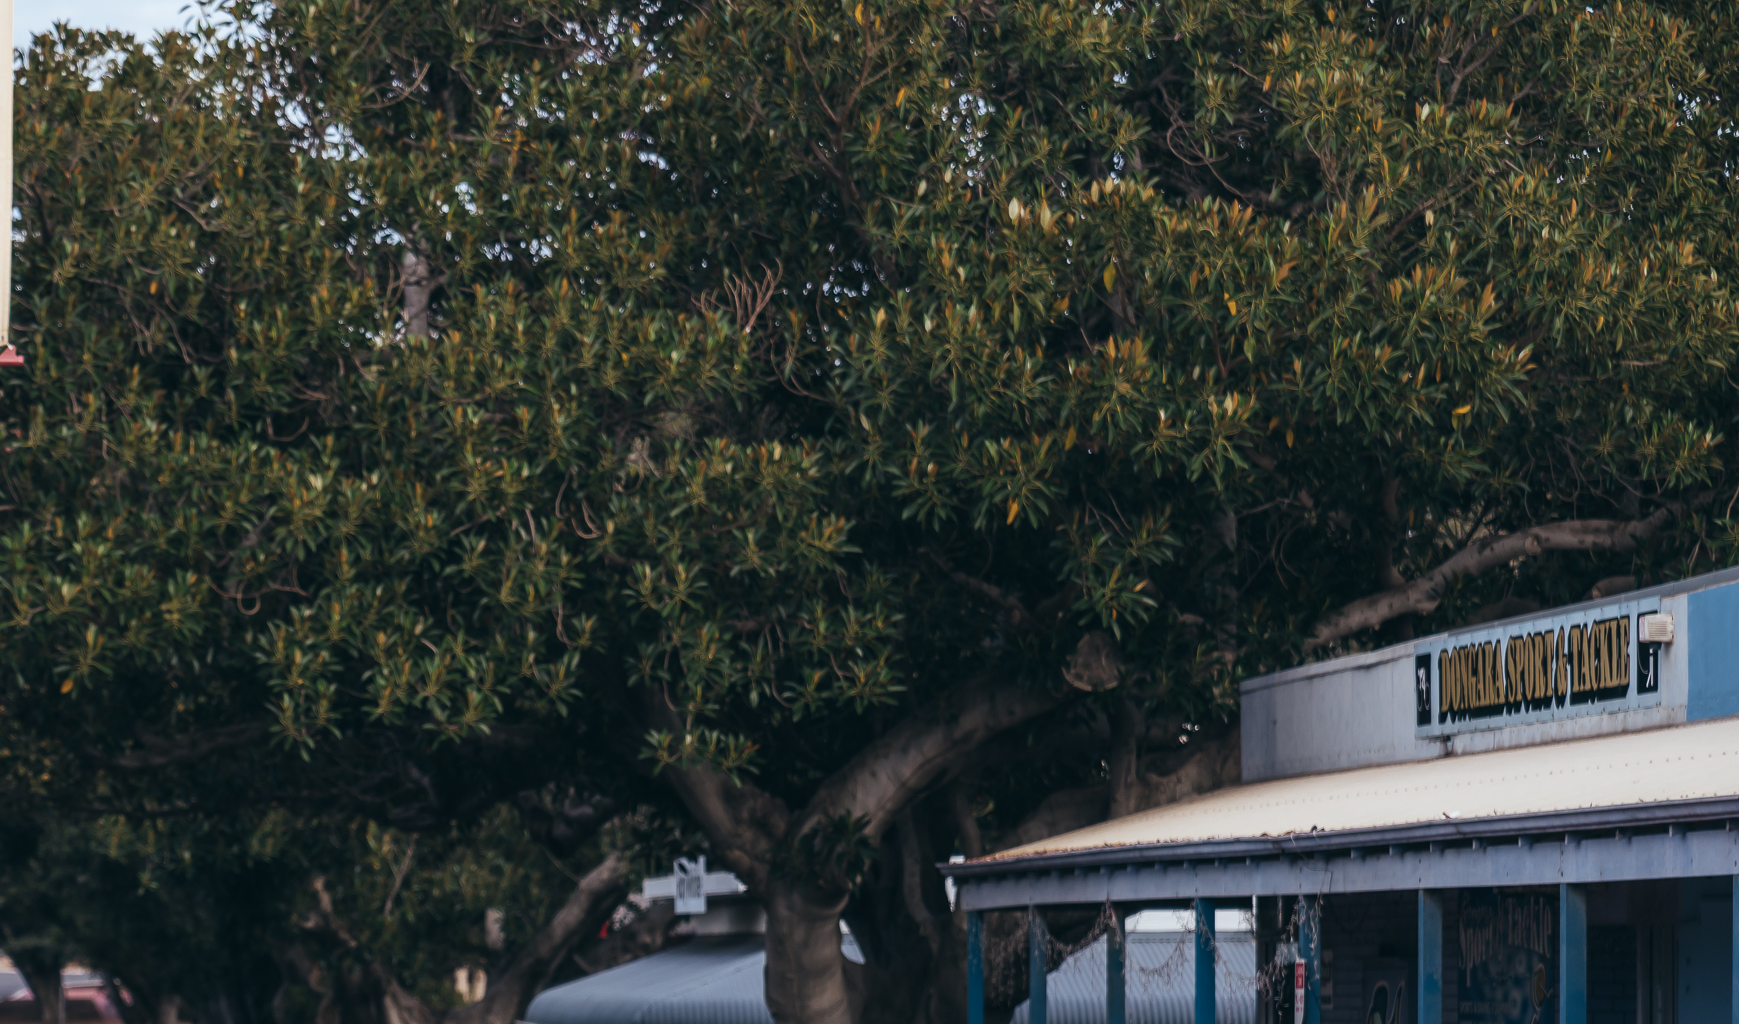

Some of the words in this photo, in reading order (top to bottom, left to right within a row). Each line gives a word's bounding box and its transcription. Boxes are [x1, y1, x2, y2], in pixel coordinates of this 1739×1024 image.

[1439, 640, 1506, 718] DONGARA
[1506, 630, 1555, 708] SPORT
[1556, 624, 1567, 703] &
[1568, 616, 1630, 700] TACKLE
[1506, 895, 1552, 959] Tackle
